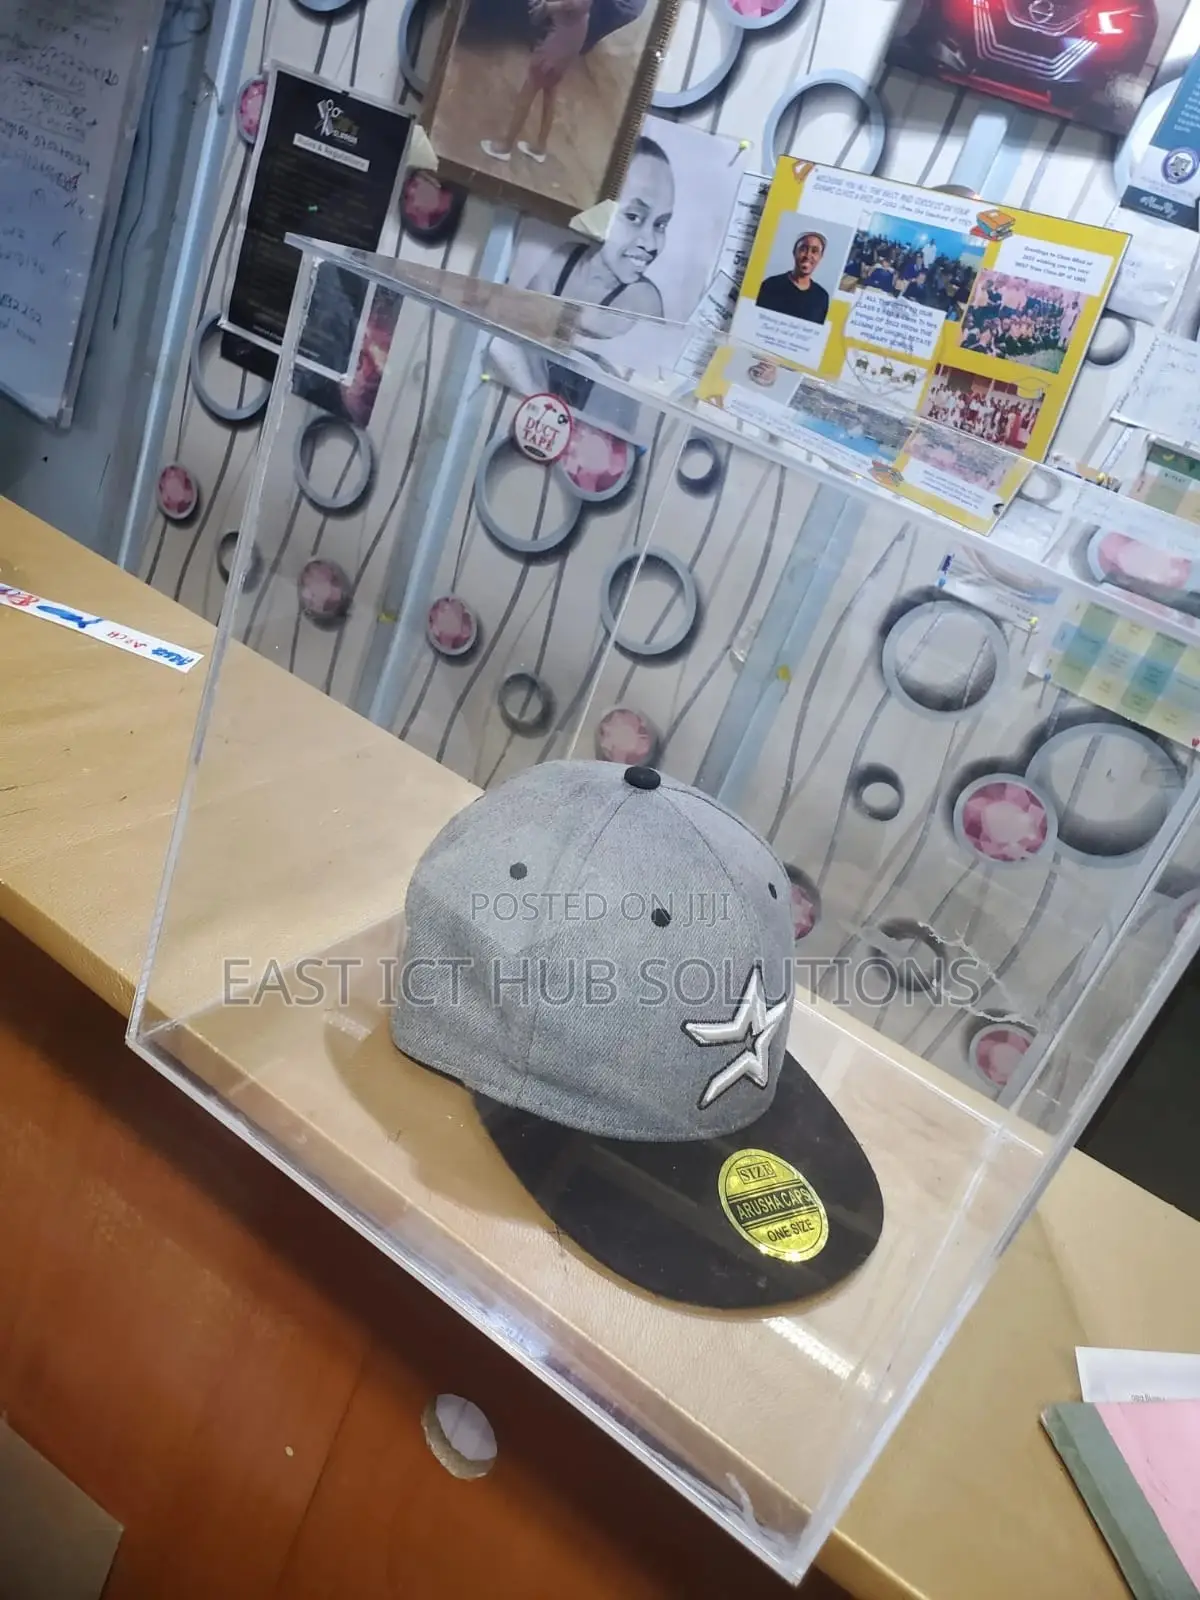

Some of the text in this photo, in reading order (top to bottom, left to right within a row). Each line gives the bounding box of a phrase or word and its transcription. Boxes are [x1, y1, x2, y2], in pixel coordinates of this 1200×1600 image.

[740, 1163, 774, 1182] SIZE
[737, 1188, 810, 1220] ARUSHA CAPS
[767, 1219, 815, 1242] ONE SIZE
